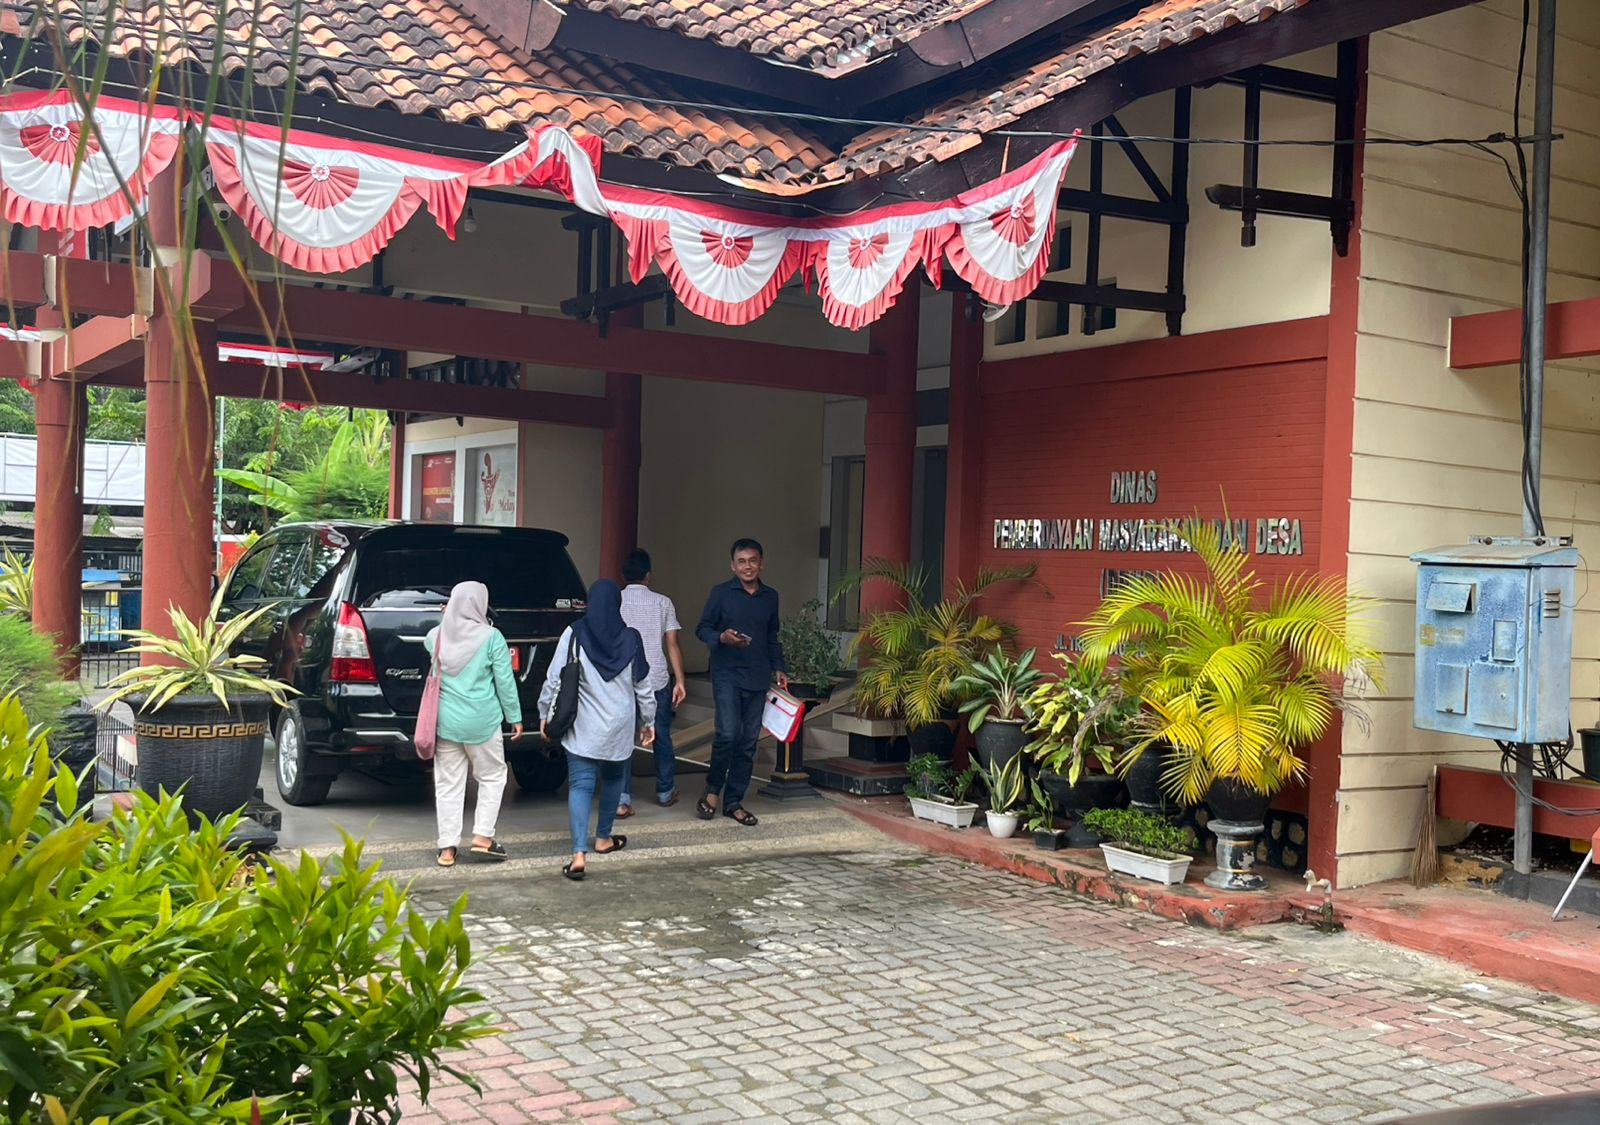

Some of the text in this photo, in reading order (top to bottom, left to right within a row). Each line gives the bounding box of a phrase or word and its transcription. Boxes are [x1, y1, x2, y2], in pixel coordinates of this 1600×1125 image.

[1110, 470, 1157, 503] DINAS
[994, 518, 1095, 550] PEMBERDAYAAN
[1256, 518, 1302, 555] DESA
